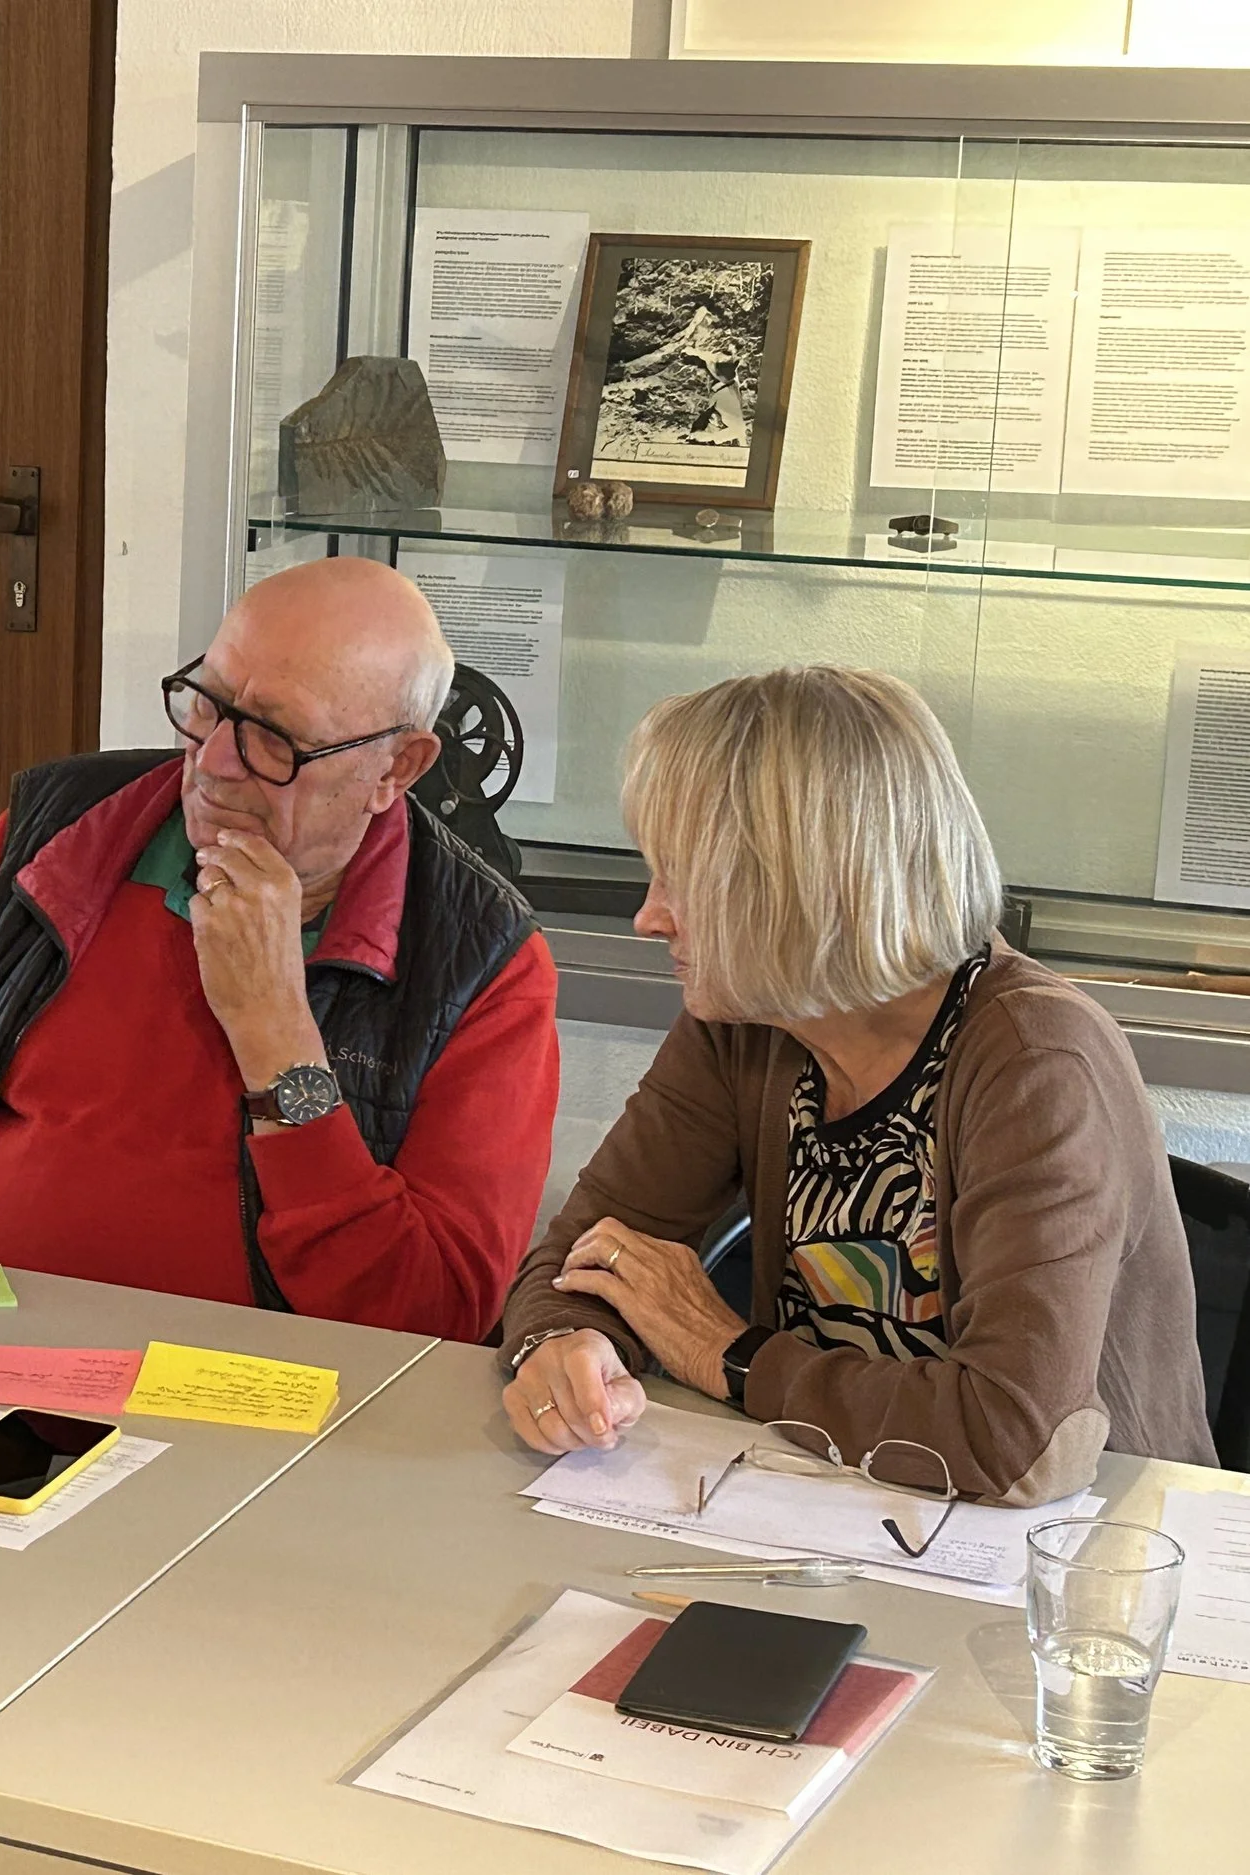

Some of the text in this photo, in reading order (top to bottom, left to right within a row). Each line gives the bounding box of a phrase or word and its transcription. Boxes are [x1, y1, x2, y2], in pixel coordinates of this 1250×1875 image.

[620, 1716, 802, 1761] ICH BIN DABEI!
